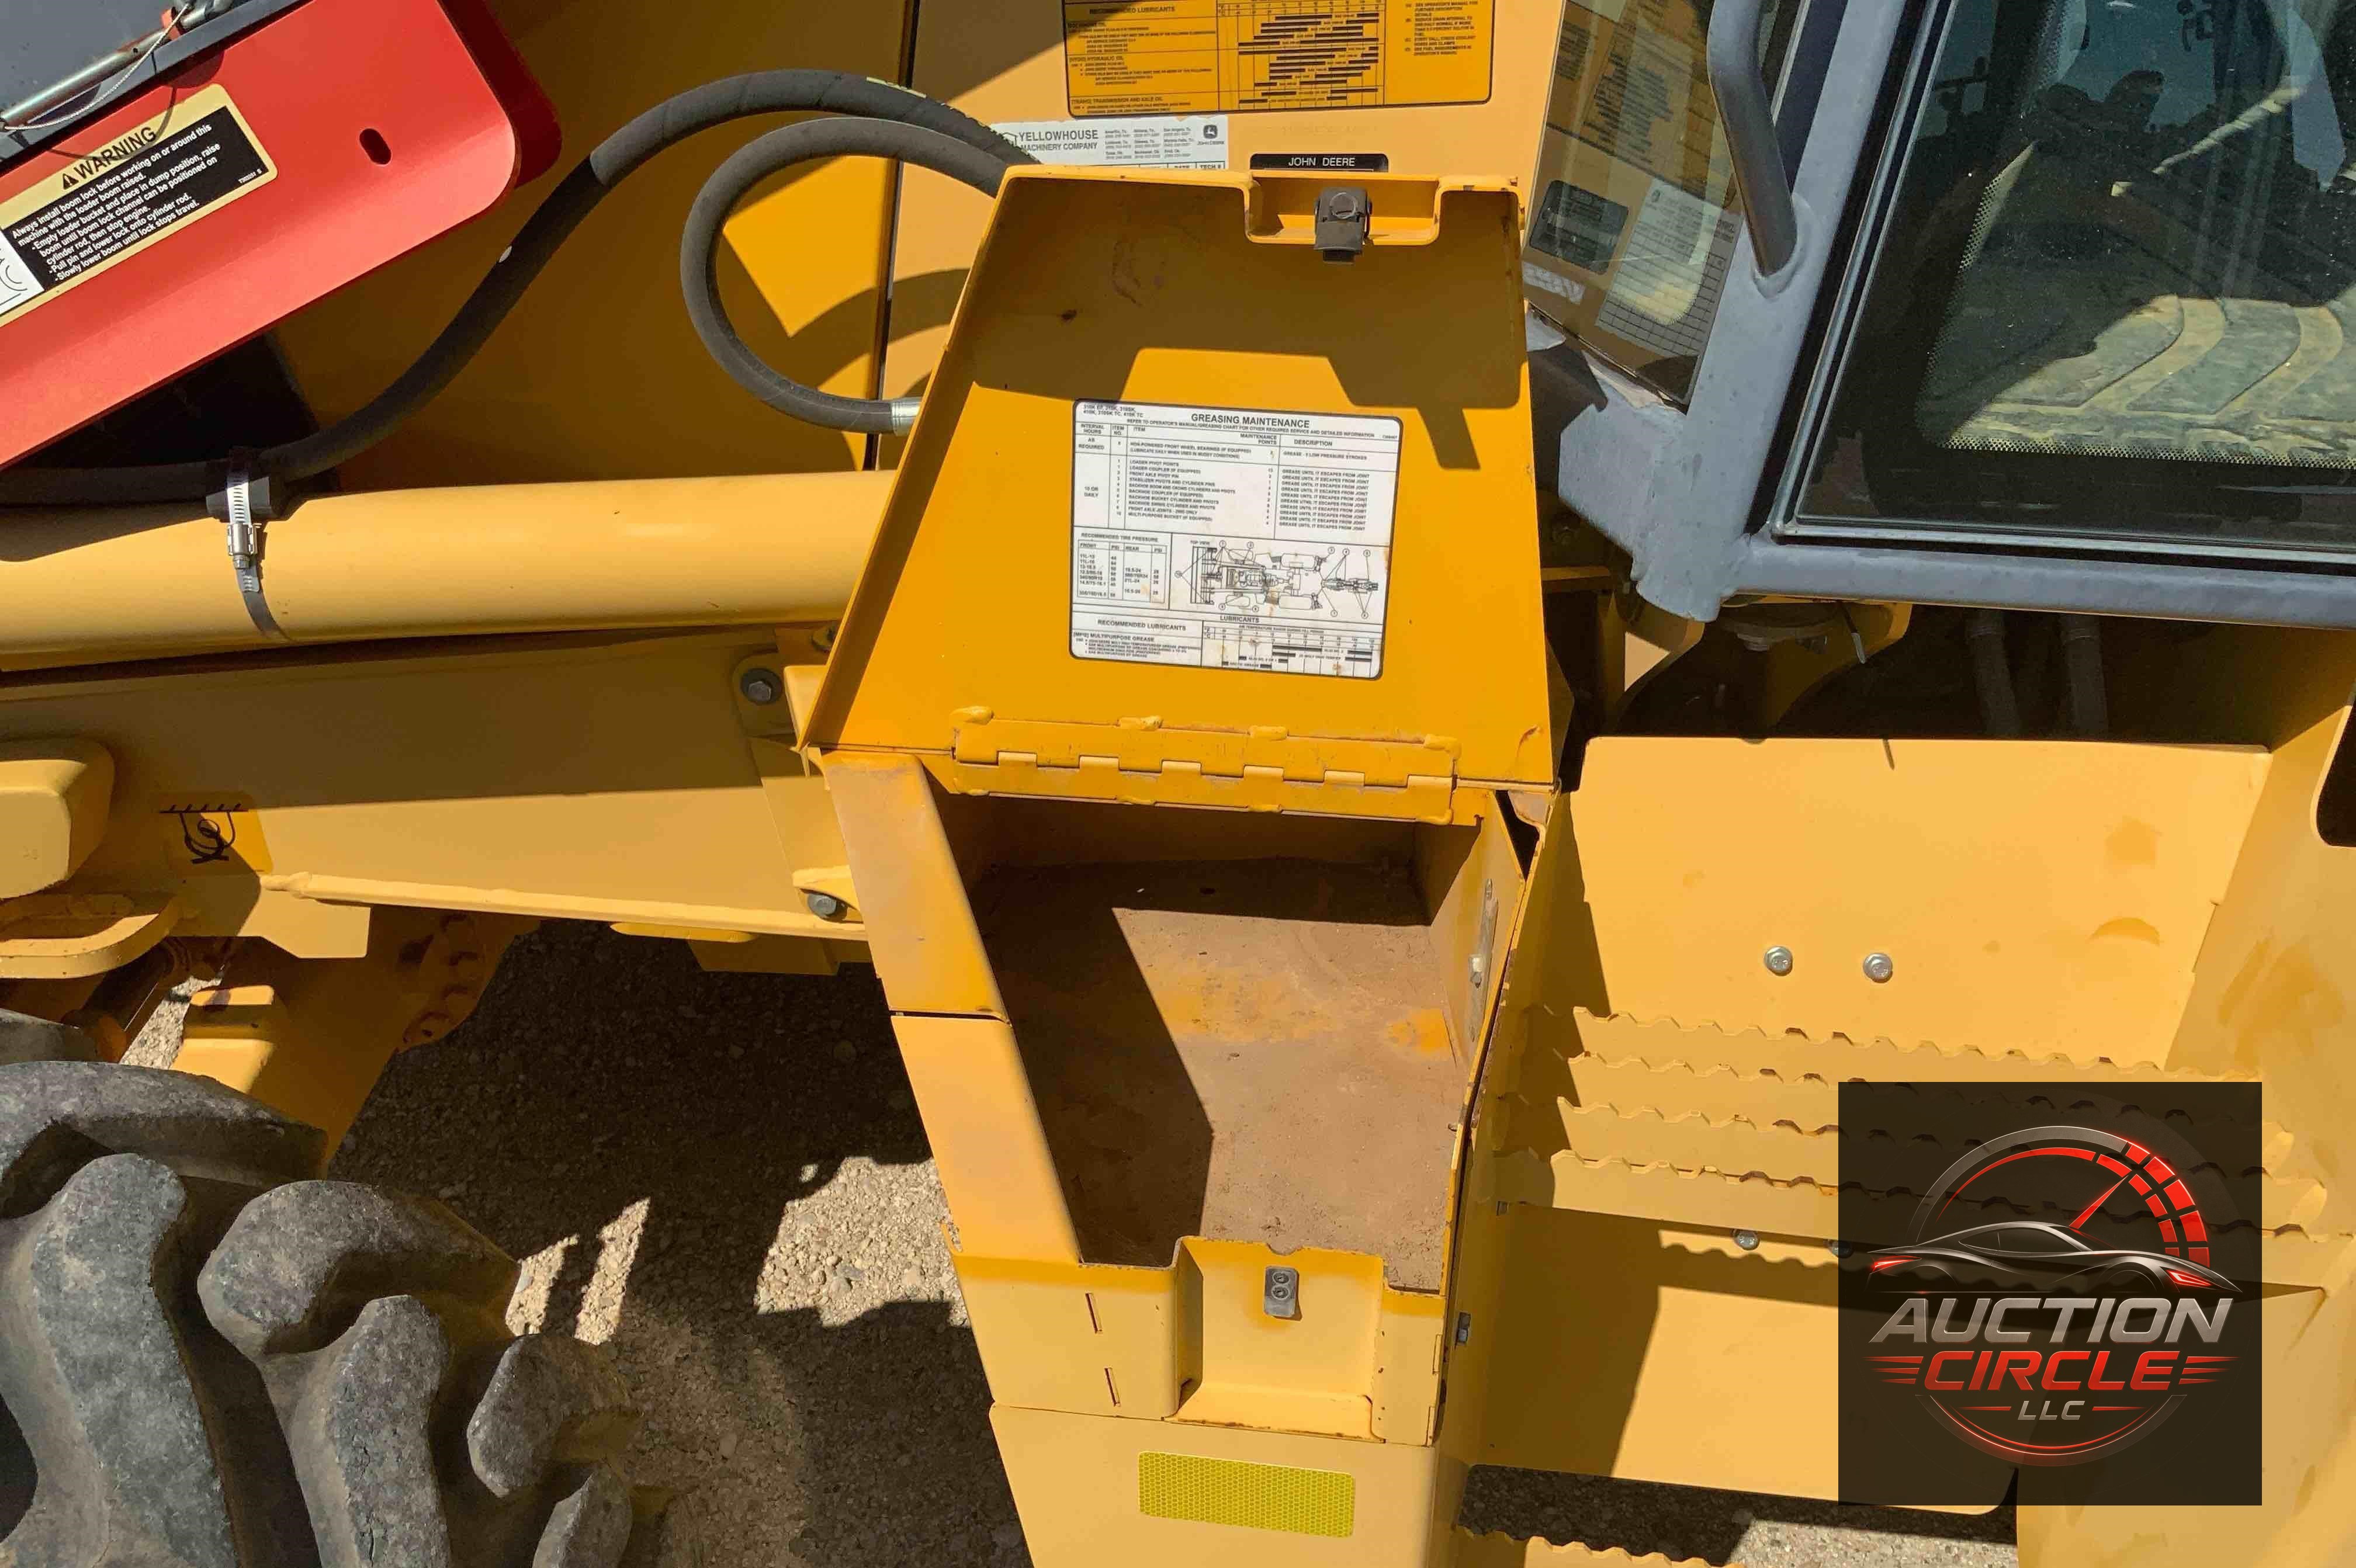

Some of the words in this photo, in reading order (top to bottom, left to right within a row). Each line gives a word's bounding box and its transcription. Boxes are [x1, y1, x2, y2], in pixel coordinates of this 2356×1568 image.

[74, 127, 157, 180] WARNING
[1018, 130, 1099, 141] YELLOWHOUSE
[1021, 143, 1061, 152] MACHINERY
[1288, 157, 1316, 166] JOHN
[1322, 158, 1356, 166] DEERE
[12, 221, 38, 238] Always
[37, 207, 61, 224] install
[58, 197, 82, 211] boom
[79, 188, 99, 200] lock
[96, 175, 121, 191] before
[120, 158, 151, 179] working
[150, 152, 161, 161] on
[161, 147, 169, 155] or
[170, 131, 197, 150] around
[196, 124, 212, 136] this
[39, 242, 61, 256] boom
[61, 232, 78, 245] until
[77, 221, 99, 236] boom
[98, 212, 116, 224] lock
[115, 195, 144, 216] channel
[144, 189, 158, 200] can
[156, 183, 168, 192] be
[168, 161, 206, 188] positioned
[206, 157, 217, 165] on
[56, 220, 80, 236] loader
[79, 206, 106, 224] bucket
[105, 197, 120, 210] and
[119, 188, 140, 204] place
[148, 171, 169, 186] dump
[169, 155, 203, 176] position,
[201, 144, 220, 157] raise
[18, 227, 48, 246] machine
[47, 217, 64, 229] with
[63, 211, 77, 220] the
[75, 198, 99, 214] loader
[98, 186, 121, 201] boom
[120, 172, 146, 189] raised.
[46, 245, 74, 264] cylinder
[74, 237, 91, 249] rod,
[88, 228, 107, 241] then
[106, 219, 123, 231] stop
[123, 206, 150, 222] engine.
[66, 255, 79, 266] pin
[79, 245, 93, 258] and
[92, 235, 113, 250] lower
[112, 226, 130, 239] lock
[129, 218, 146, 230] onto
[147, 202, 175, 220] cylinder
[175, 193, 191, 204] rod.
[80, 253, 101, 267] lower
[100, 242, 123, 256] boom
[122, 231, 139, 244] until
[138, 223, 155, 235] lock
[155, 213, 176, 227] stops
[175, 200, 199, 216] travel.
[1191, 413, 1239, 424] GREASING
[1242, 415, 1310, 428] MAINTENANCE
[1097, 619, 1146, 629] RECOMMENDED
[1147, 623, 1186, 632] LUBRICANTS
[1219, 615, 1259, 623] LUBRICANTS
